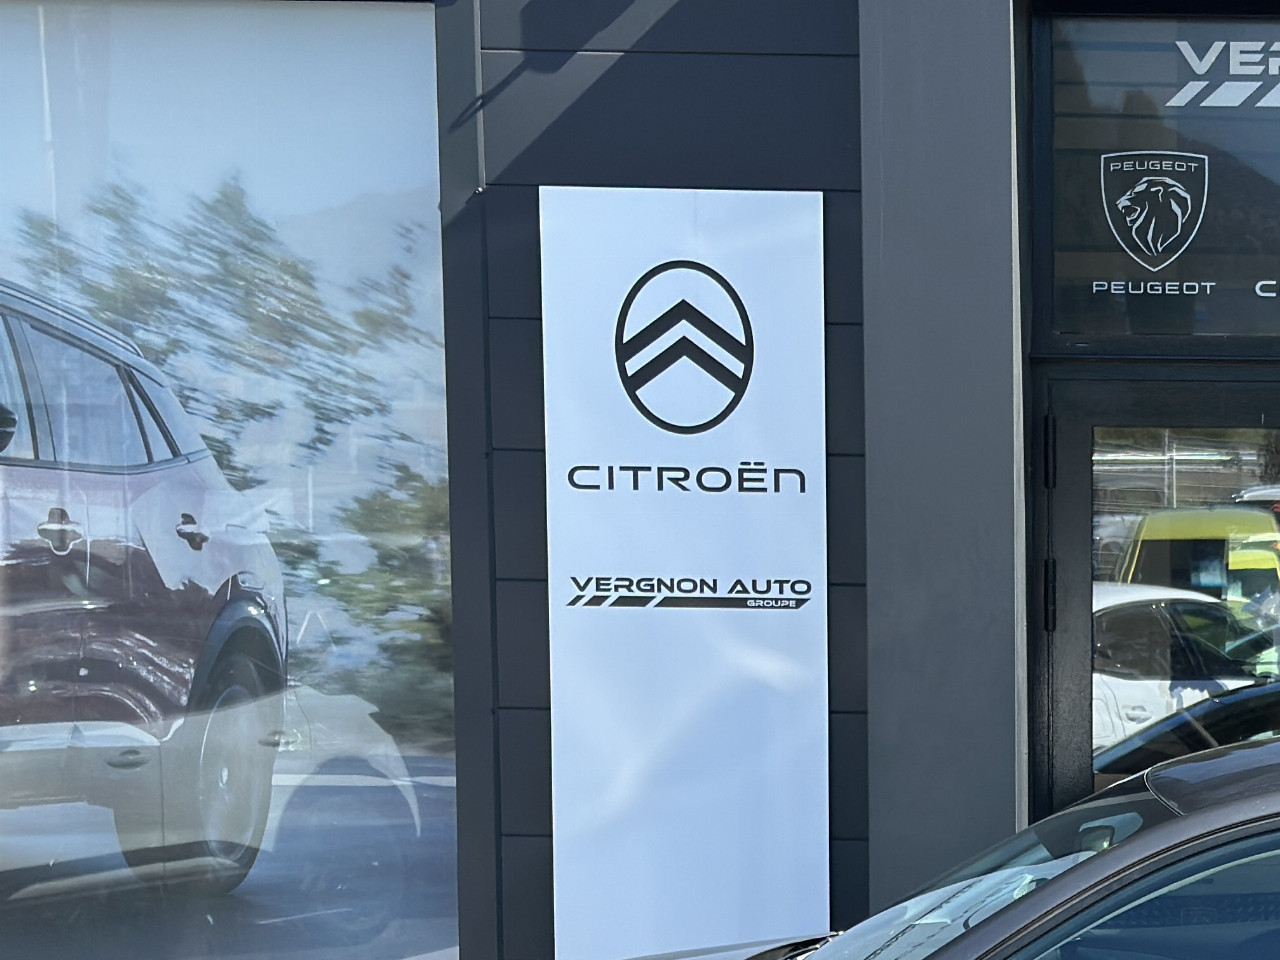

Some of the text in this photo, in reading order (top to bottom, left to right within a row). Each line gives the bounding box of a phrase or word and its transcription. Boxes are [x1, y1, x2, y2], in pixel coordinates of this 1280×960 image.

[1111, 161, 1198, 171] PEUGEOT
[1093, 282, 1216, 294] PEUGEOT
[570, 577, 811, 595] VERGNON AUTO
[747, 600, 796, 609] GROUPE
